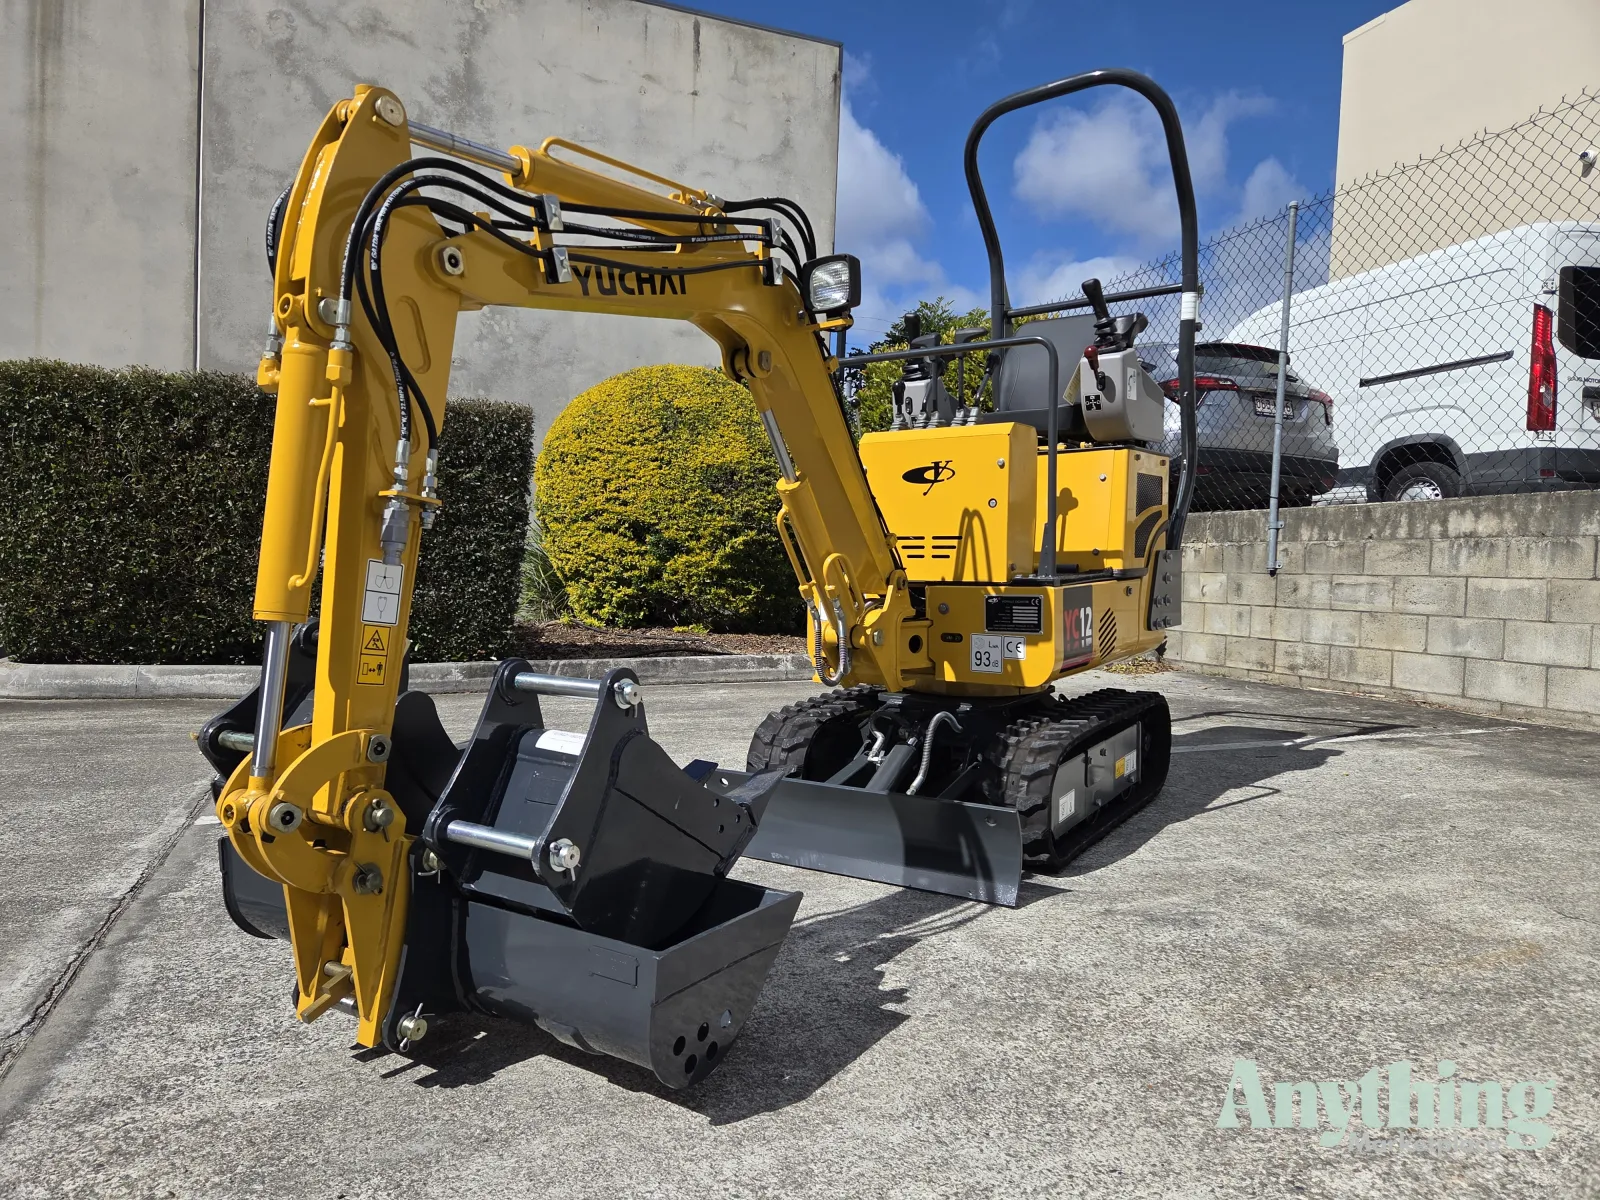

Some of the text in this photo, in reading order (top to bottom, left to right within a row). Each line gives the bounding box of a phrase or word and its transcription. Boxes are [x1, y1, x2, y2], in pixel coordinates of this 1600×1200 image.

[571, 265, 686, 296] YUCHAI
[1064, 607, 1092, 641] YC12
[974, 650, 991, 667] 93
